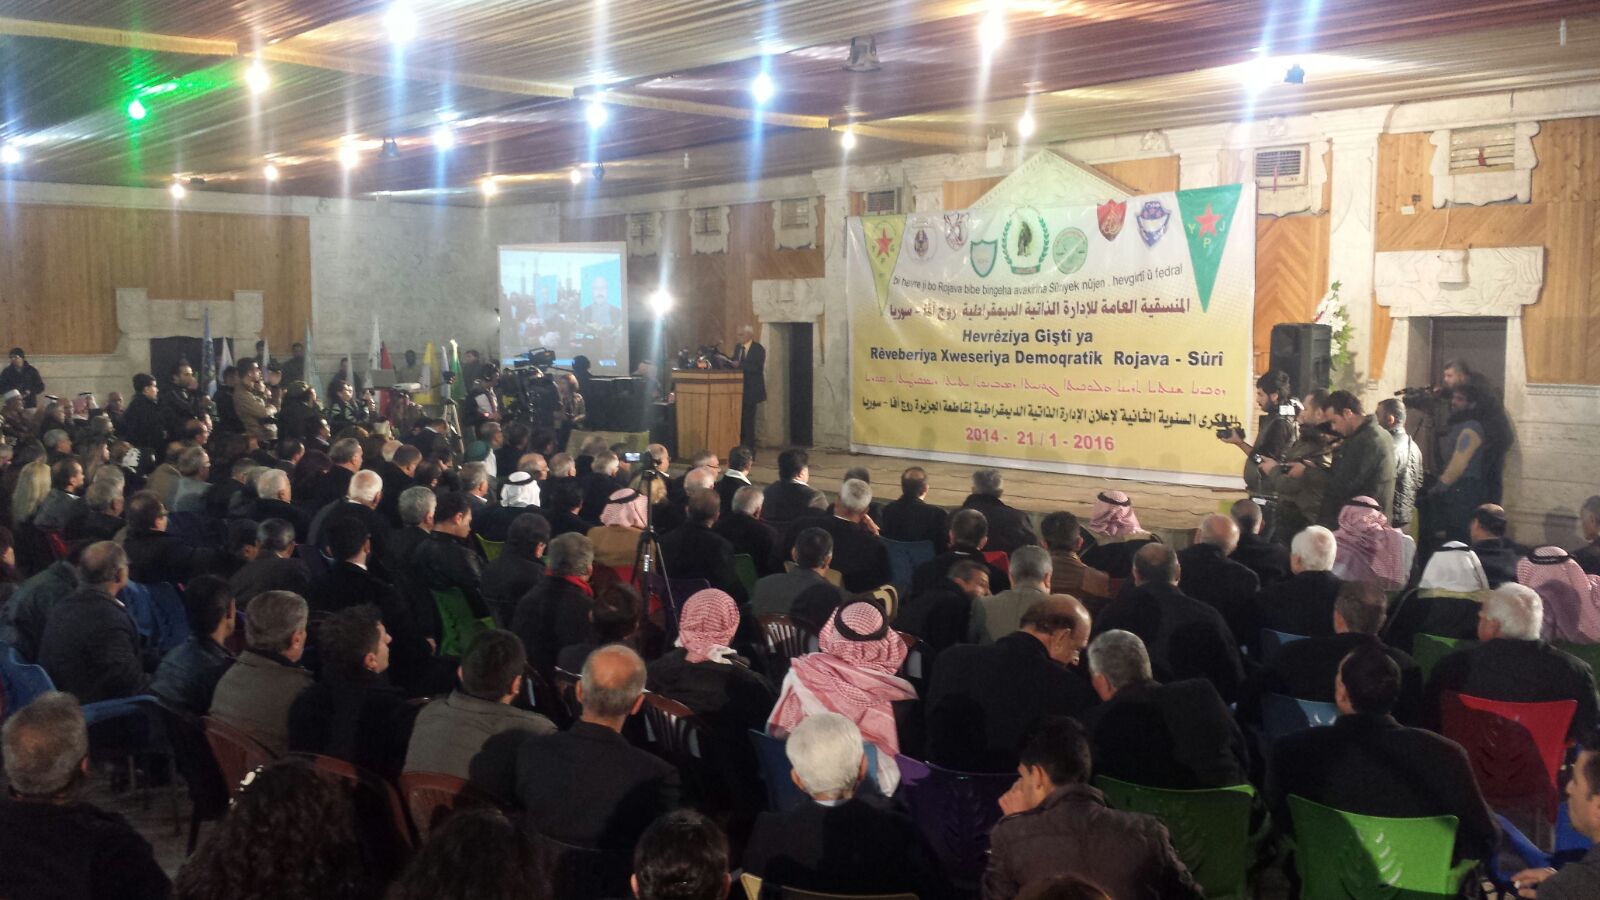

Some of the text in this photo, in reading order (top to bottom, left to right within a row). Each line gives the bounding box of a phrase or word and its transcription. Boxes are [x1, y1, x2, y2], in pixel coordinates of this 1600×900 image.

[938, 281, 963, 295] Rojava
[889, 303, 913, 321] سوريا
[1101, 298, 1137, 314] العامة
[962, 328, 1093, 346] Hevrêziya Giştî ya
[870, 347, 937, 364] Rêveberiya
[941, 349, 1010, 367] Xweseriya
[1015, 349, 1103, 368] Demoqratîk
[1114, 351, 1169, 369] Rojava
[1187, 350, 1223, 367] Sûrî
[1120, 407, 1157, 426] الثانية
[1158, 409, 1196, 429] السنوية
[965, 427, 999, 442] 2014
[1073, 434, 1114, 450] 2016
